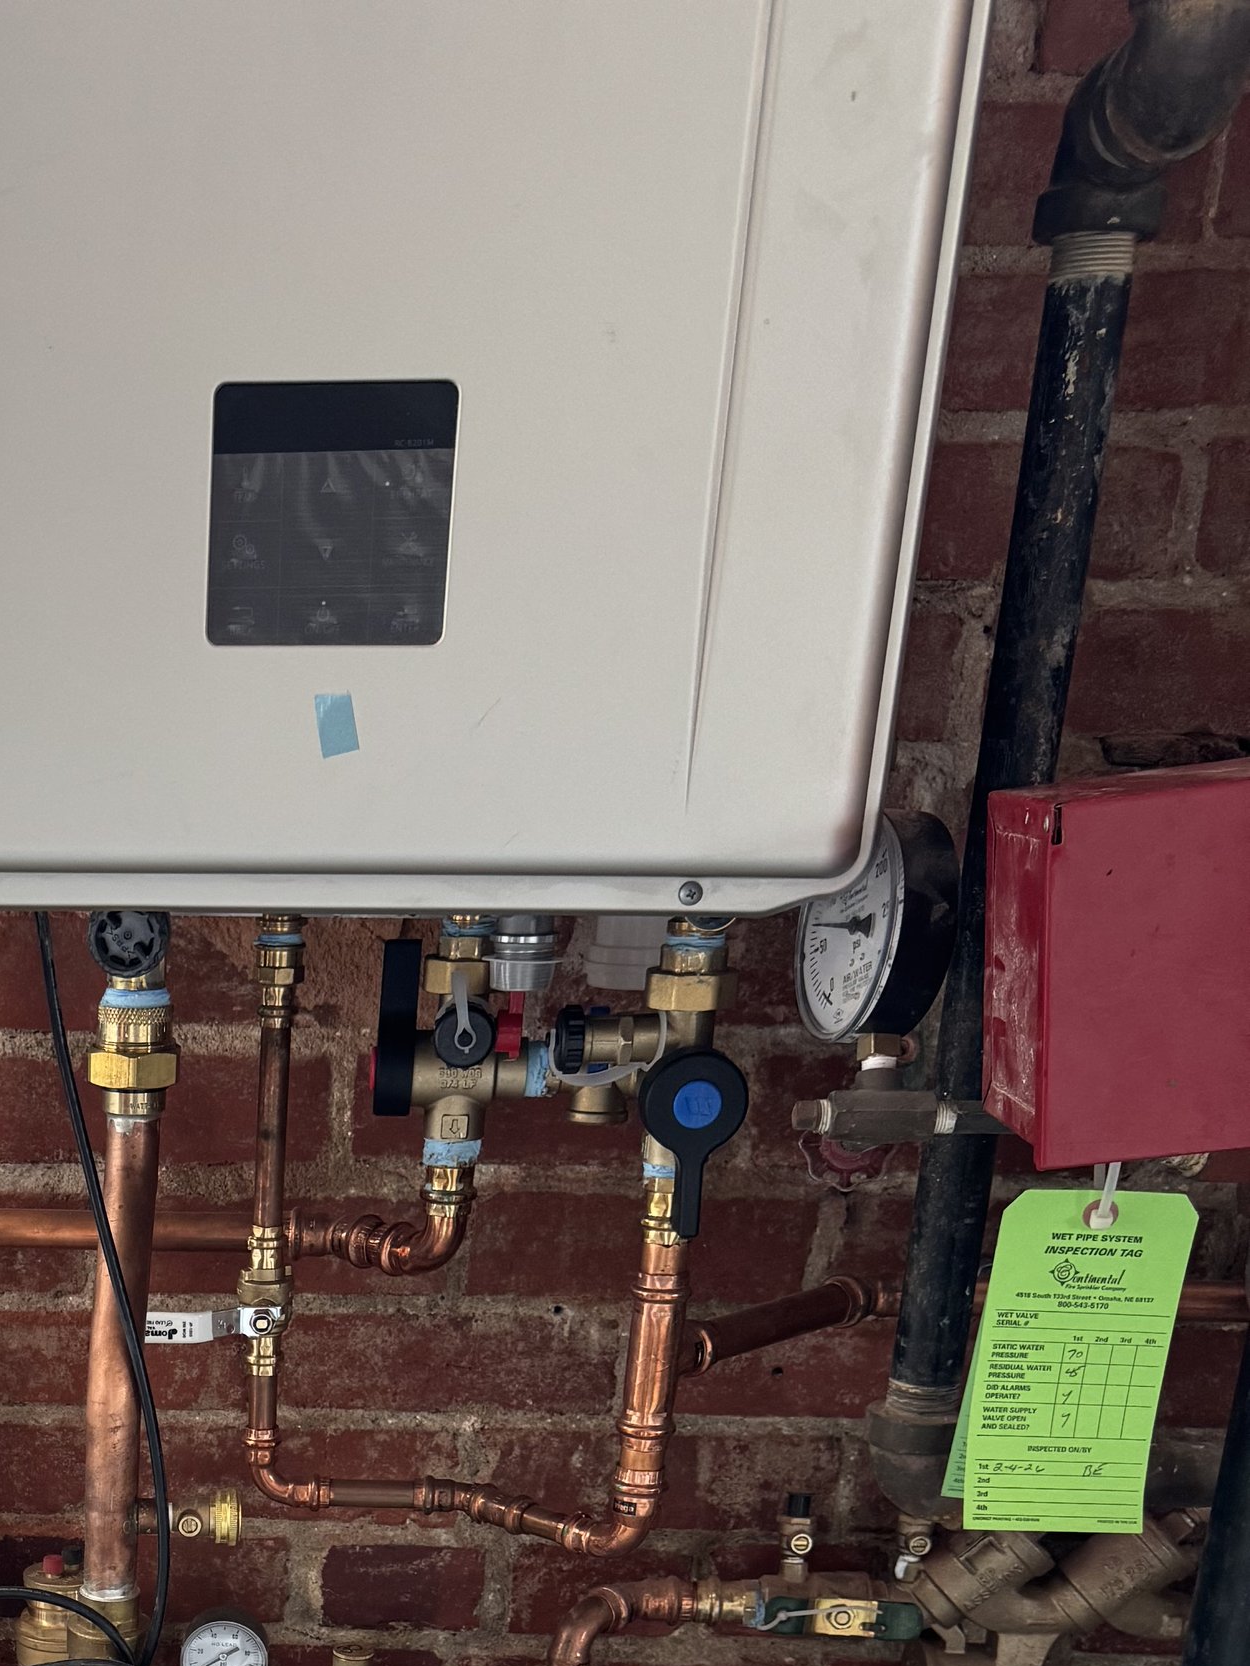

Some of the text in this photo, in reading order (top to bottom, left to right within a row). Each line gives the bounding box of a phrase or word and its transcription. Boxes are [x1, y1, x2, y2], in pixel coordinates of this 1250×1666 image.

[875, 858, 888, 879] 200
[819, 938, 827, 954] 50
[829, 977, 834, 992] 0
[1052, 1232, 1143, 1243] WET PIPE SYSTEM
[1045, 1246, 1143, 1258] INSPECTION TAG
[1053, 1262, 1126, 1285] Continental
[1057, 1301, 1109, 1310] 800-543-5170
[145, 1329, 178, 1340] Joma
[1068, 1349, 1083, 1359] 70
[1027, 1445, 1067, 1453] INSPECTED
